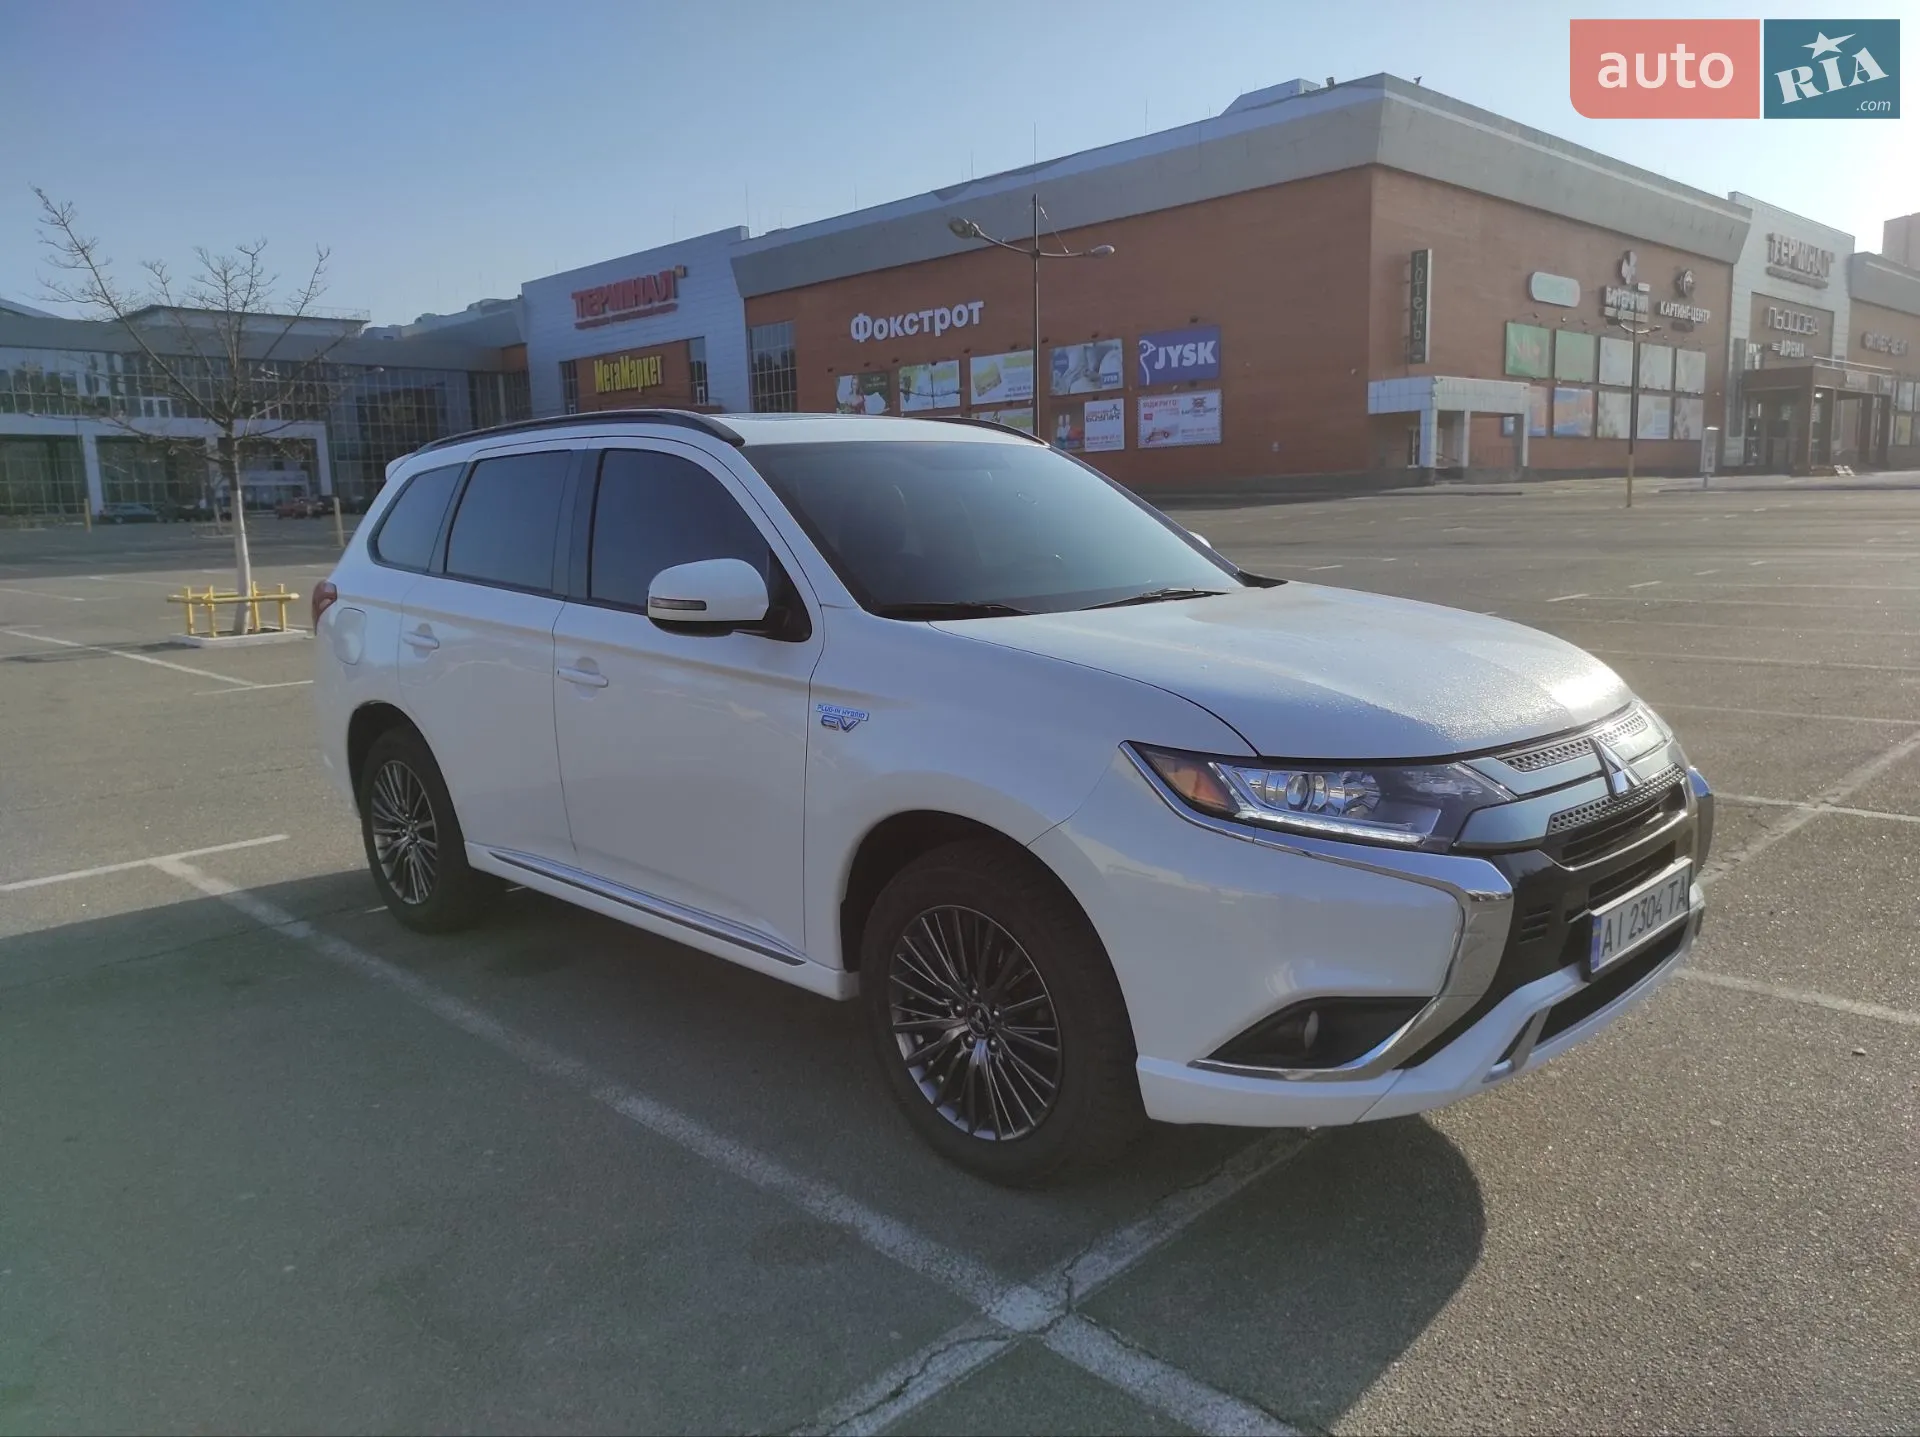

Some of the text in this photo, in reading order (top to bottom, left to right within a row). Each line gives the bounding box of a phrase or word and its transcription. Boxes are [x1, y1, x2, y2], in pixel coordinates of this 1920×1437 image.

[1154, 340, 1216, 370] JYSK
[594, 354, 662, 393] МегаМаркет
[817, 704, 841, 714] PLUG-IN
[1601, 911, 1623, 957] AI
[1628, 889, 1663, 940] 2304
[1667, 876, 1686, 917] TA
